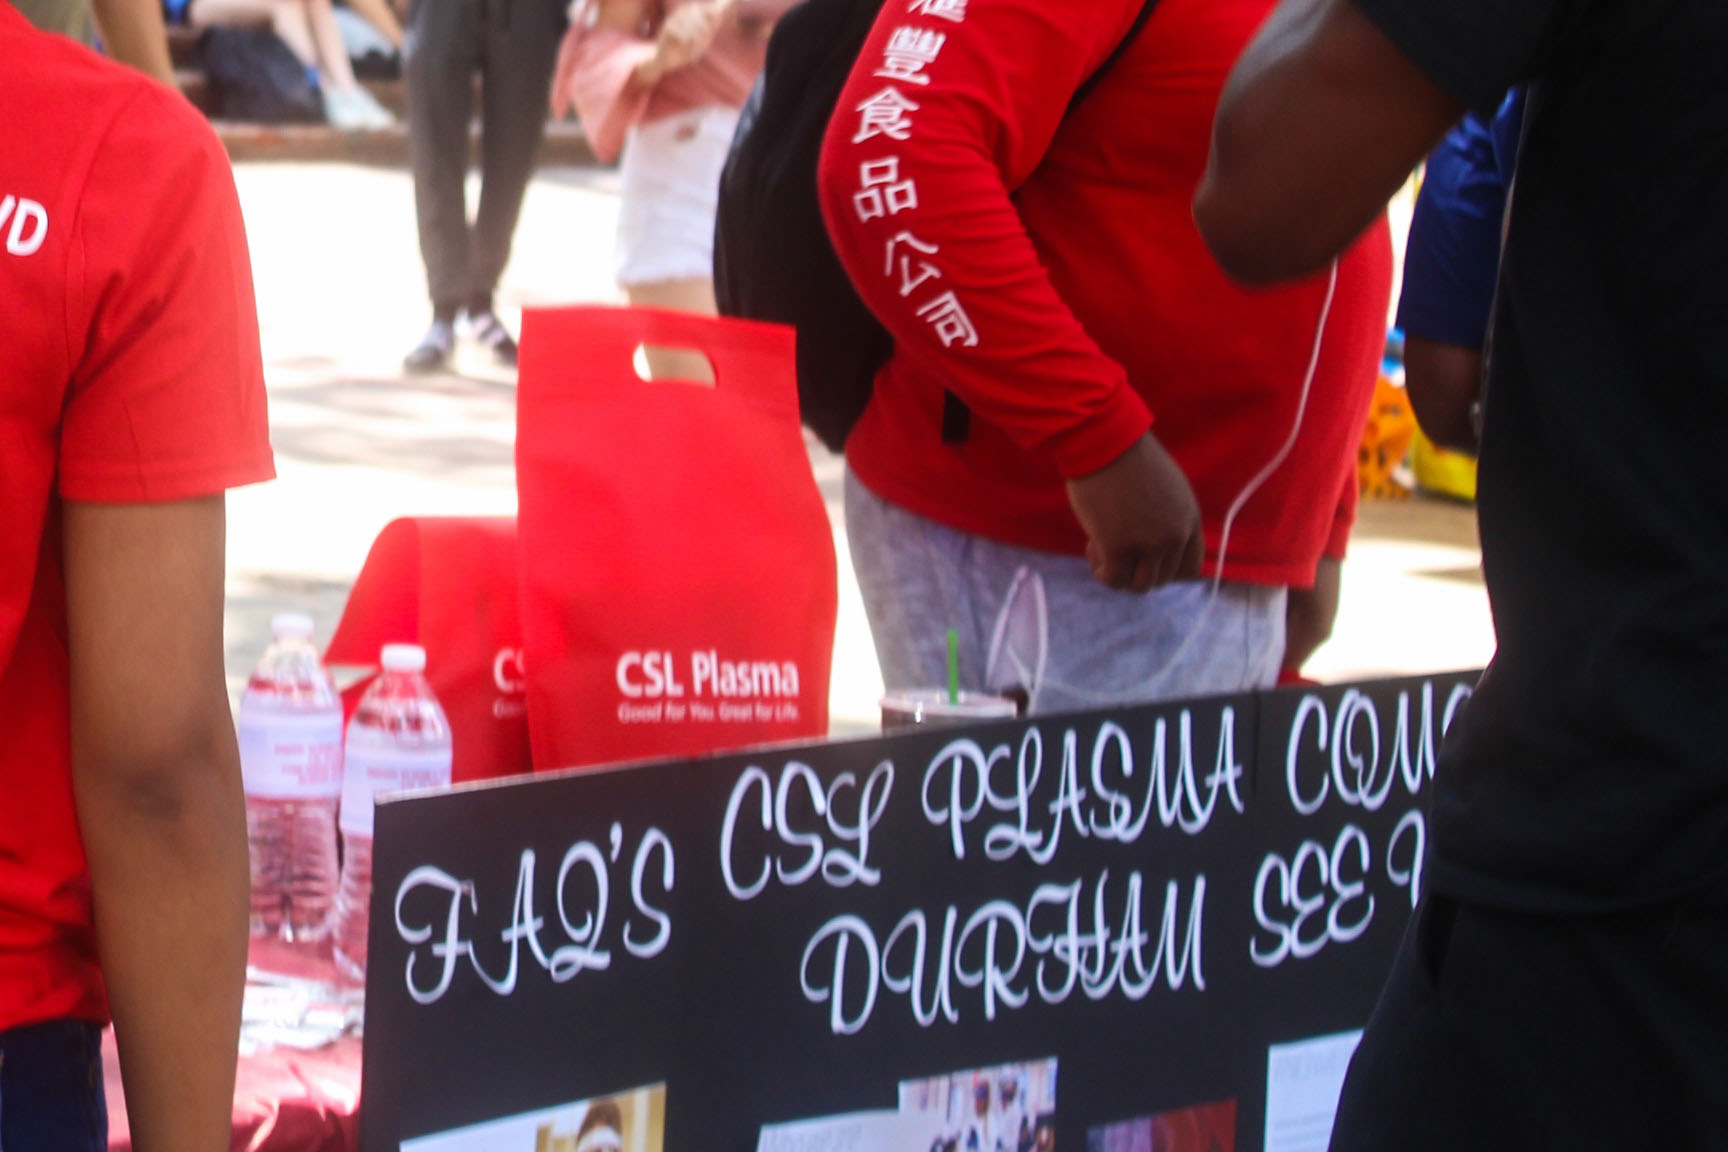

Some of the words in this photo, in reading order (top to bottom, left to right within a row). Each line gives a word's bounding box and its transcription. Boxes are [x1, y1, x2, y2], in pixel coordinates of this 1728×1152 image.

[616, 650, 684, 698] CSL
[691, 648, 800, 698] Plasma
[921, 706, 1245, 865] PLASMA
[1286, 680, 1474, 815] COM
[393, 820, 675, 1006] FAQ'S
[800, 867, 1206, 1036] DURHAM
[1249, 822, 1375, 969] SEE
